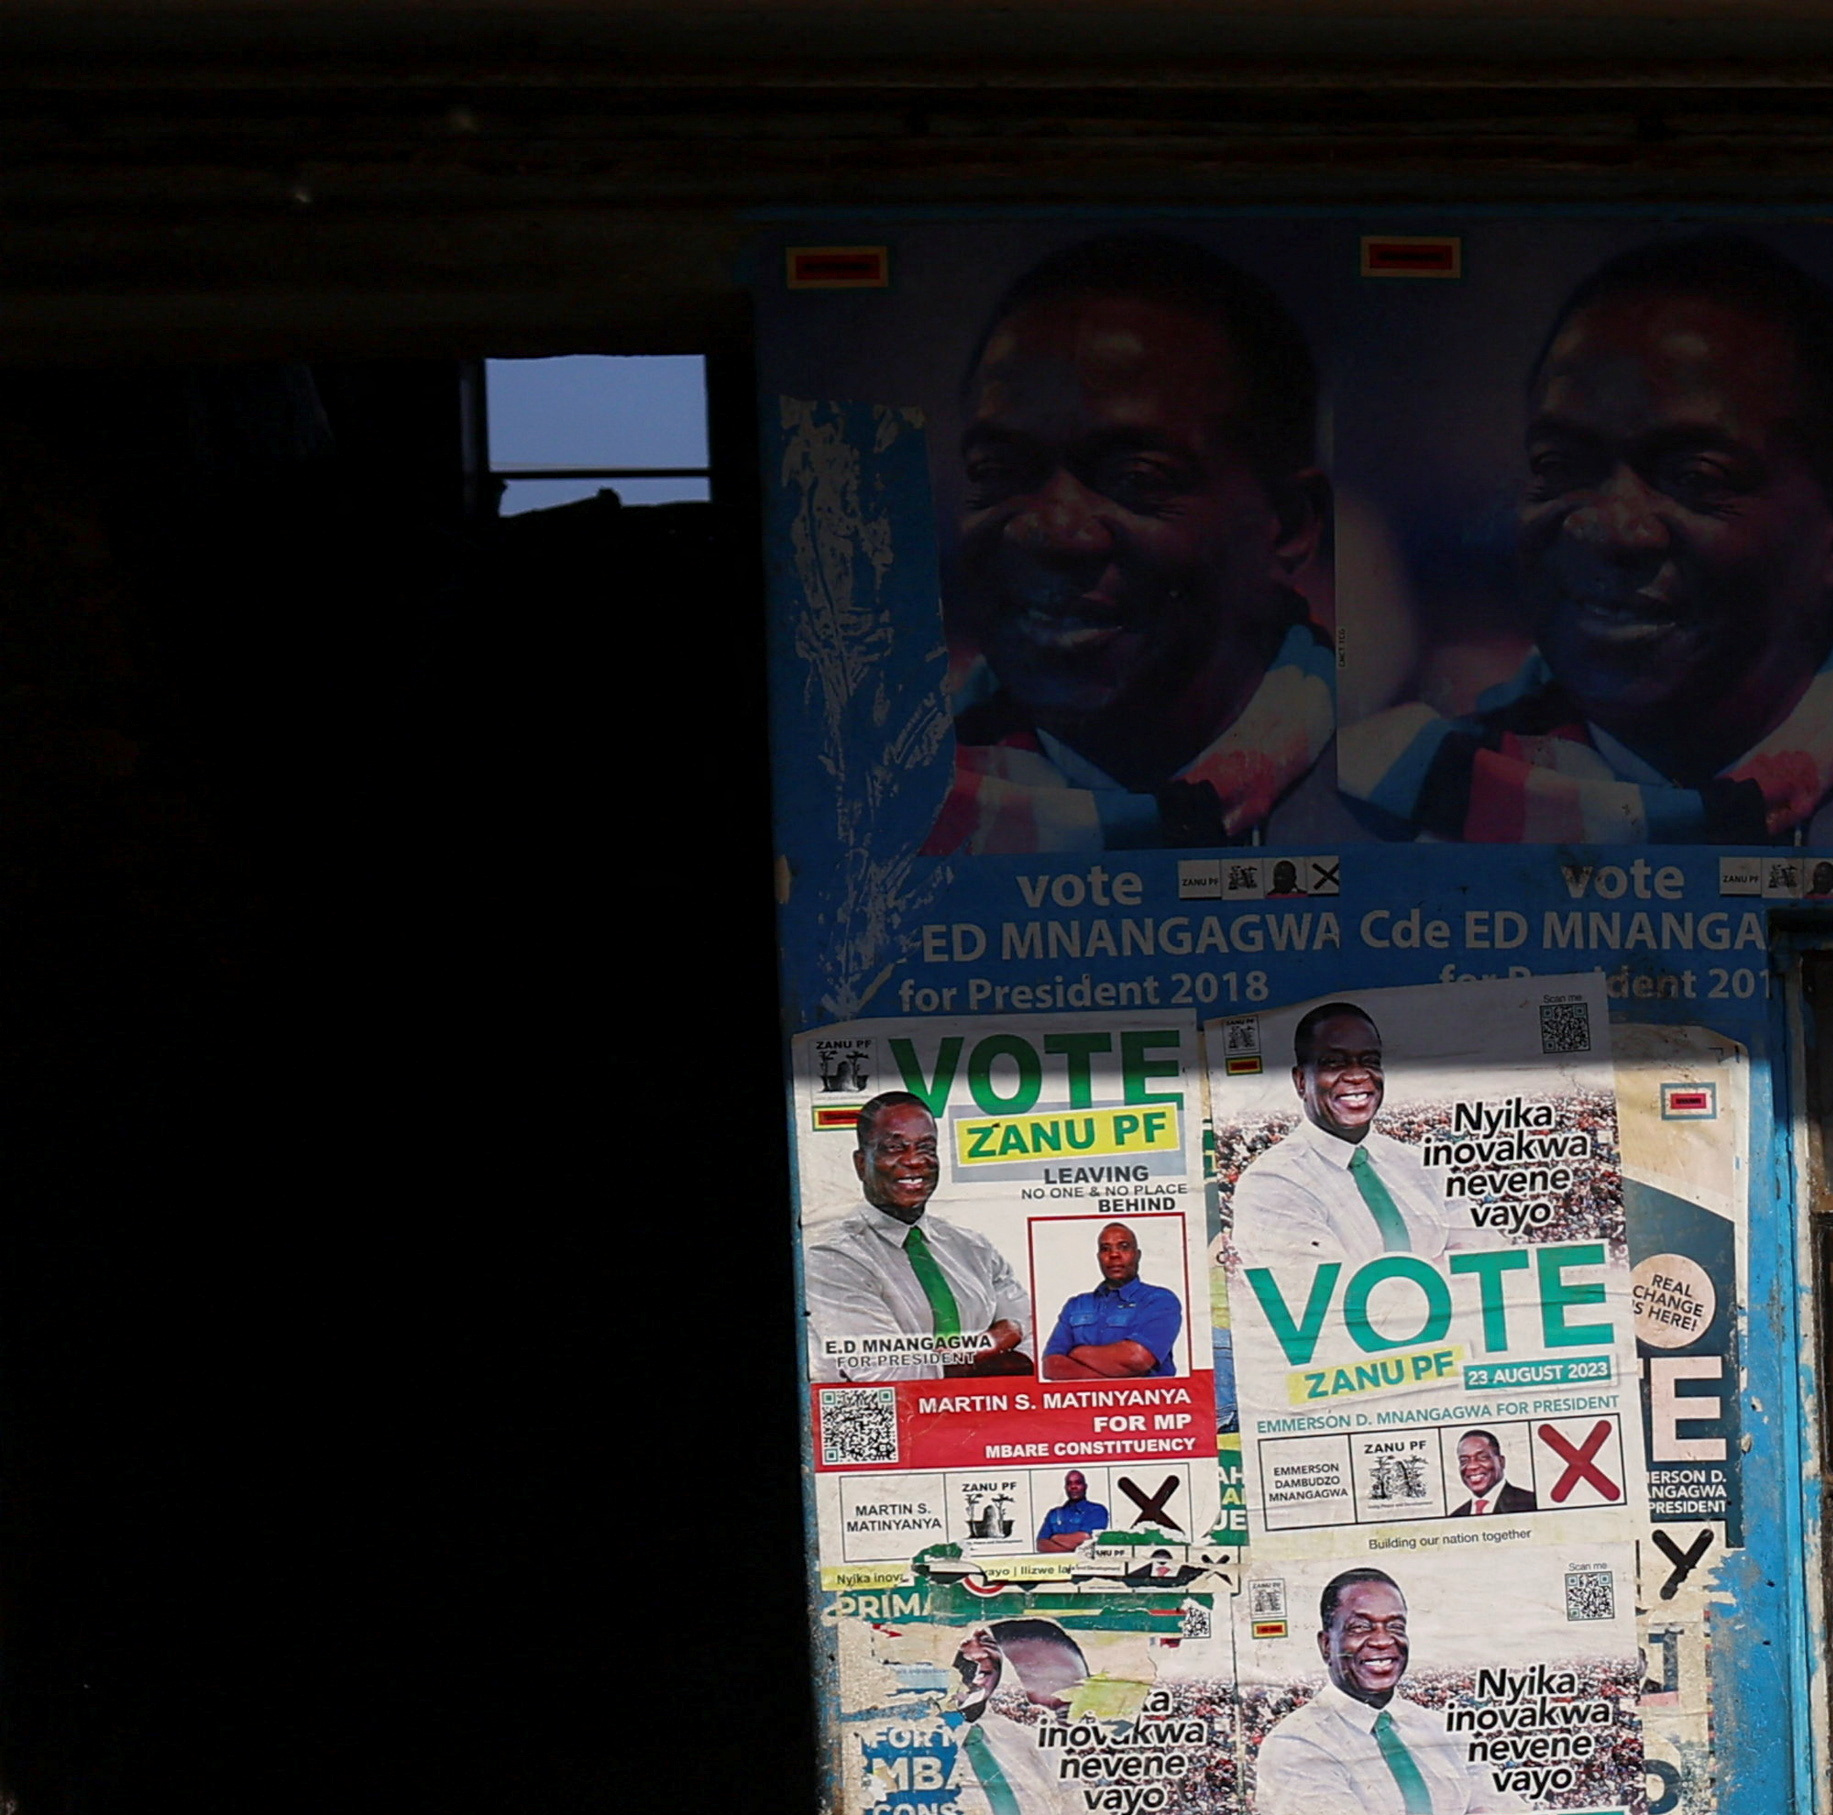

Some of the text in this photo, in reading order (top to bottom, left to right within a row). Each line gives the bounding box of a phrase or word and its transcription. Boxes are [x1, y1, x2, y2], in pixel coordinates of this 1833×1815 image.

[1016, 865, 1142, 908] vote
[1561, 858, 1685, 900] vote
[923, 911, 1339, 963] ED MNANGAGWA
[1360, 909, 1451, 949] Cde
[1464, 911, 1529, 949] ED
[899, 971, 1269, 1011] for President 2018
[889, 1031, 1183, 1118] VOTE
[1453, 1098, 1554, 1136] Nyika
[967, 1112, 1166, 1158] ZANU PF
[1423, 1131, 1589, 1166] inovakwa
[1044, 1165, 1149, 1184] LEAVING
[1445, 1169, 1571, 1197] nevene
[1021, 1183, 1187, 1199] NO ONE & NO PLACE
[1099, 1198, 1175, 1213] BEHIND
[1471, 1200, 1552, 1236] vayo
[1651, 1273, 1692, 1299] REAL
[1243, 1245, 1614, 1366] VOTE
[1632, 1285, 1704, 1317] CHANGE
[826, 1334, 991, 1354] E.D MNANGAGWA
[837, 1352, 976, 1367] FOR PRESIDENT
[1305, 1352, 1455, 1399] ZANU PF
[1468, 1362, 1608, 1385] 23 AUGUST 2023
[919, 1389, 1191, 1413] MARTIN S. MATINYANYA
[1094, 1413, 1191, 1432] FOR MP
[1257, 1396, 1619, 1433] EMMERSON D. MNANGAGWA FOR PRESIDENT
[986, 1438, 1196, 1458] MBARE CONSTITUENCY
[1364, 1440, 1427, 1454] ZANU PF
[1273, 1463, 1340, 1476] EMMERSON
[962, 1481, 1016, 1492] ZANU PF
[1275, 1476, 1340, 1489] DAMBUDZO
[1269, 1488, 1349, 1502] MNANGAGWA
[855, 1503, 930, 1516] MARTIN S.
[847, 1517, 942, 1532] MATINYANYA
[1369, 1528, 1531, 1552] Building our nation together
